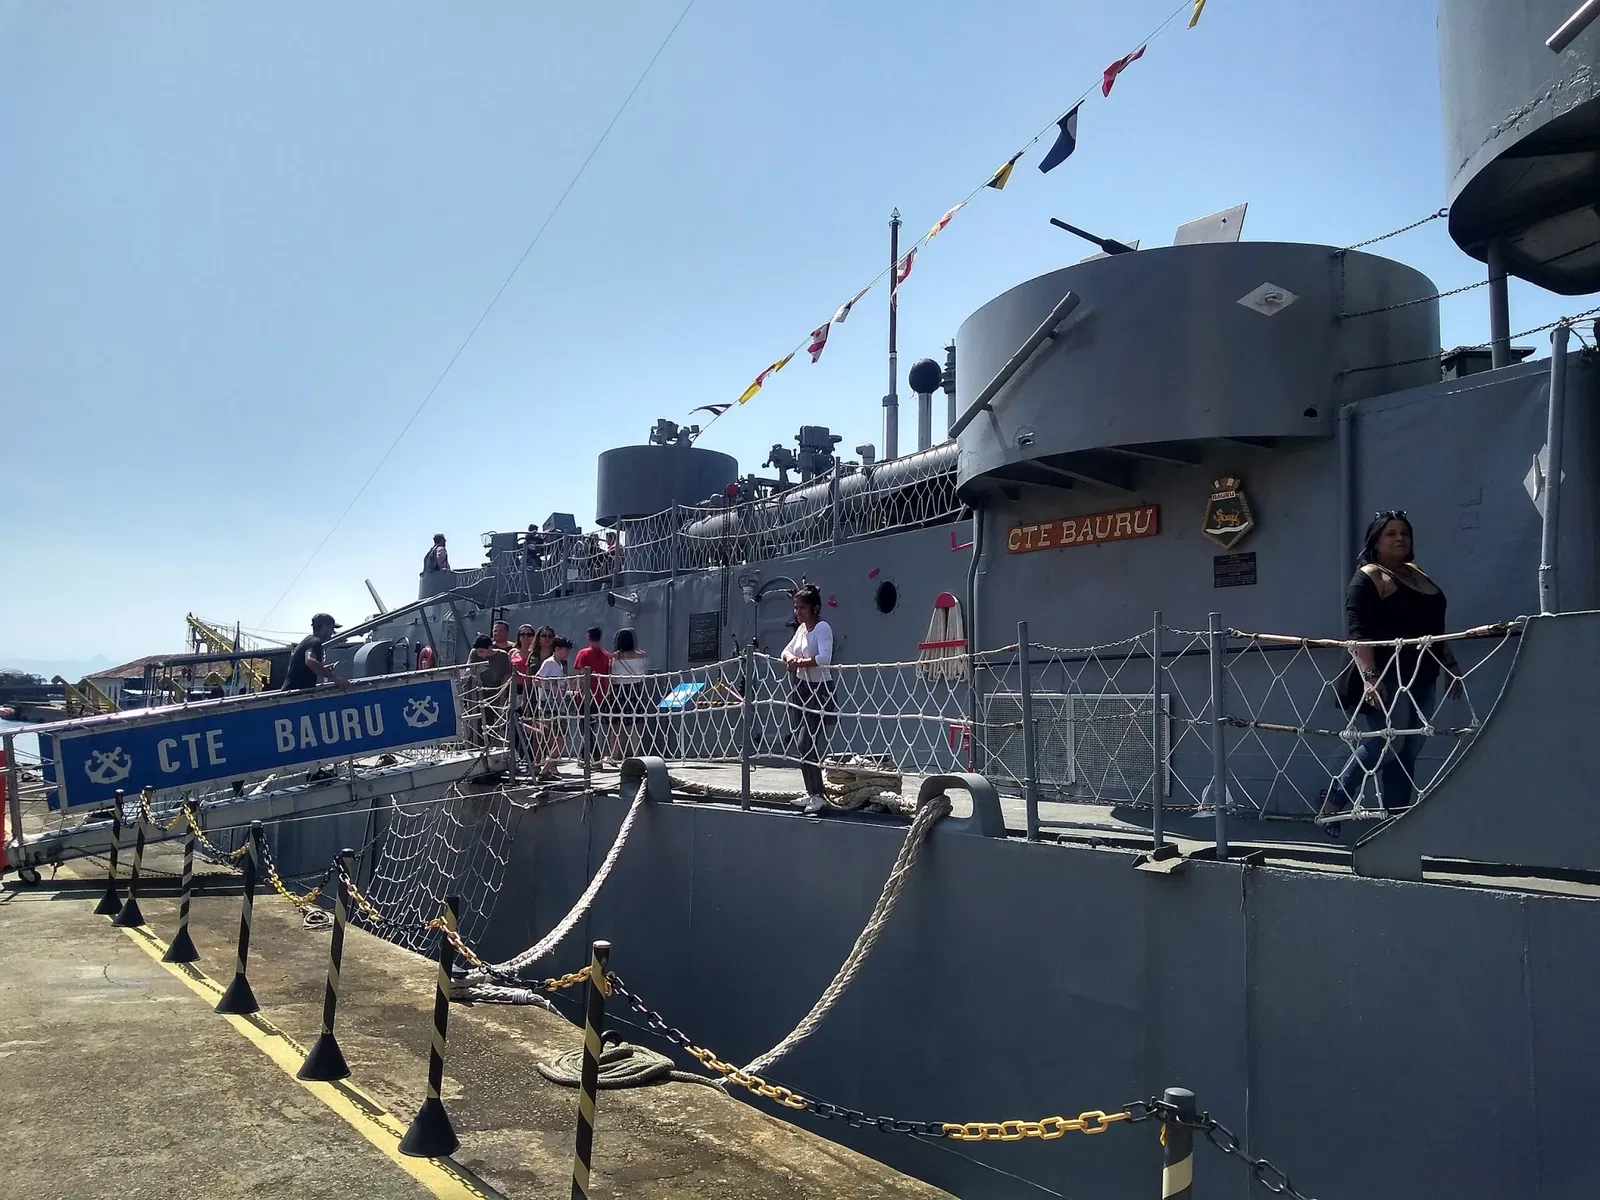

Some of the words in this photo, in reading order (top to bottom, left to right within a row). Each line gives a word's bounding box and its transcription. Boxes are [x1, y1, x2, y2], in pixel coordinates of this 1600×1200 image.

[1212, 491, 1236, 500] BAURU
[1008, 523, 1052, 550] CTE
[1060, 508, 1153, 544] BAURU
[157, 729, 227, 773] CTE
[274, 703, 384, 753] BAURU
